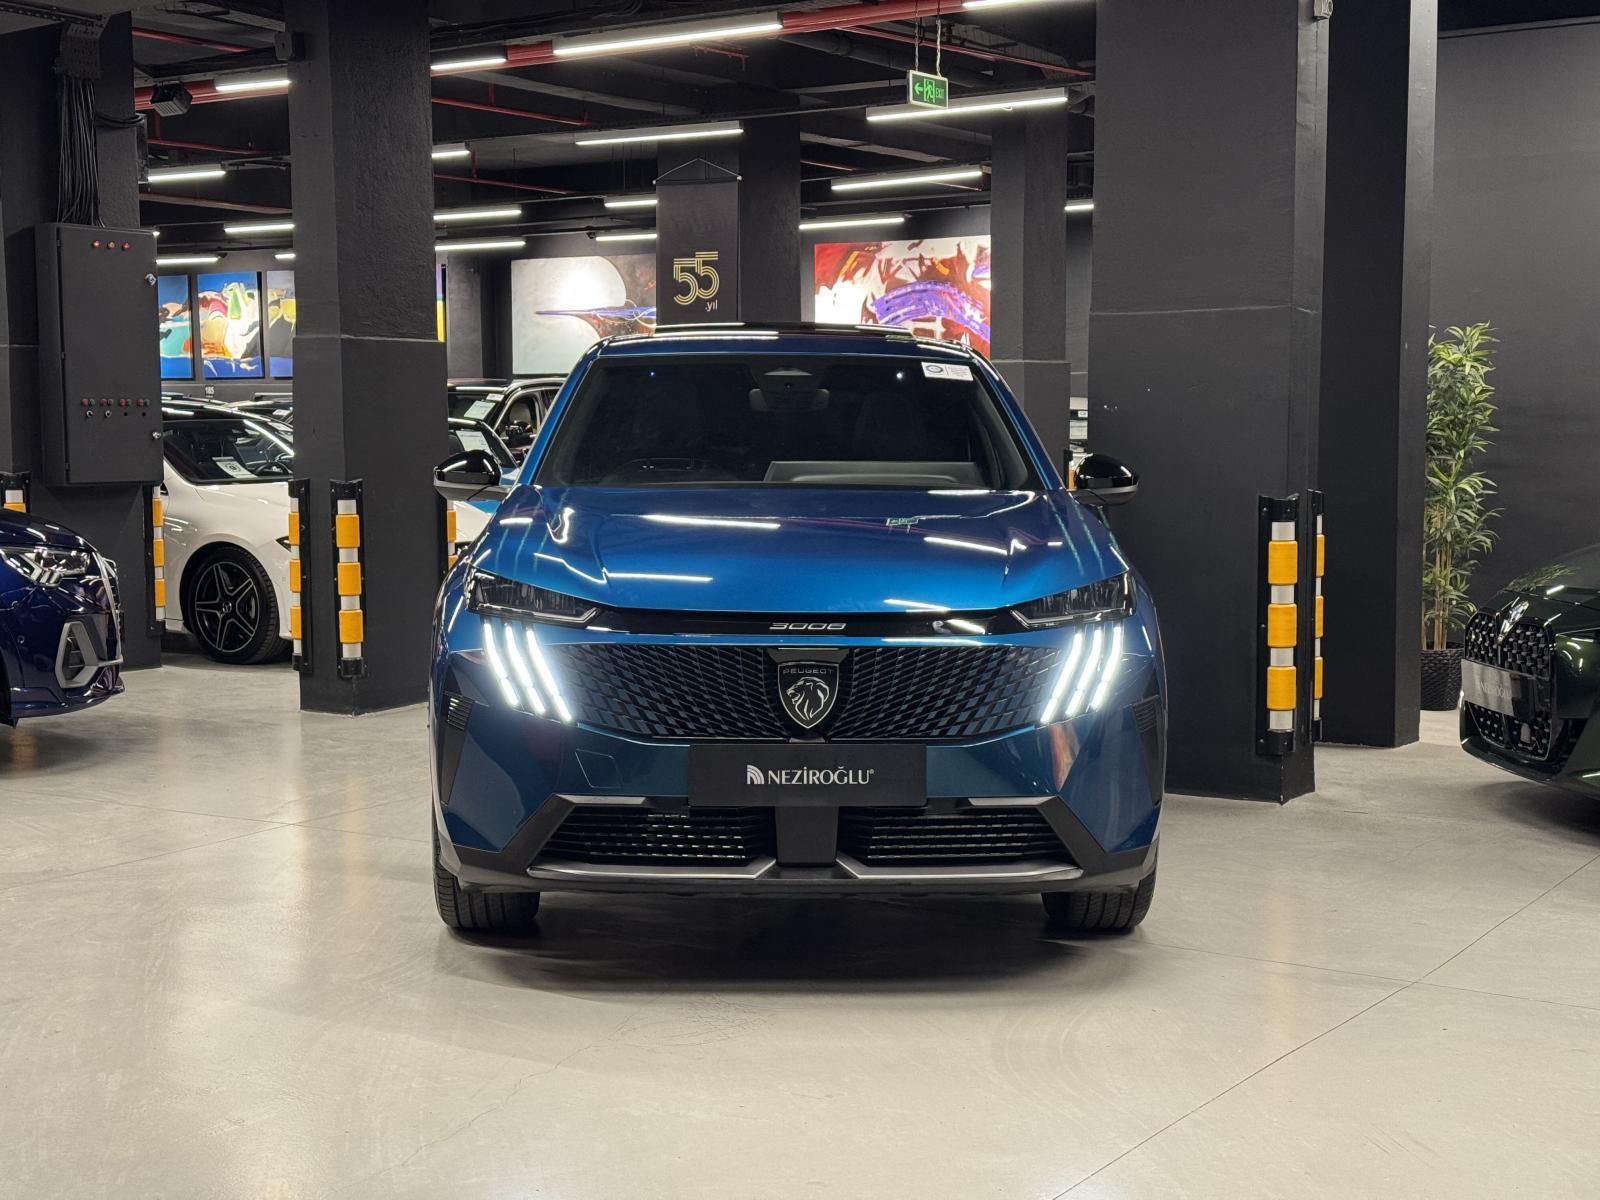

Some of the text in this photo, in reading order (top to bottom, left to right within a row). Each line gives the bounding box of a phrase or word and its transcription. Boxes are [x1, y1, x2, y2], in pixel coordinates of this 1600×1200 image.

[673, 251, 720, 305] 55
[769, 622, 847, 630] 3008
[782, 666, 834, 675] PEUGEOT
